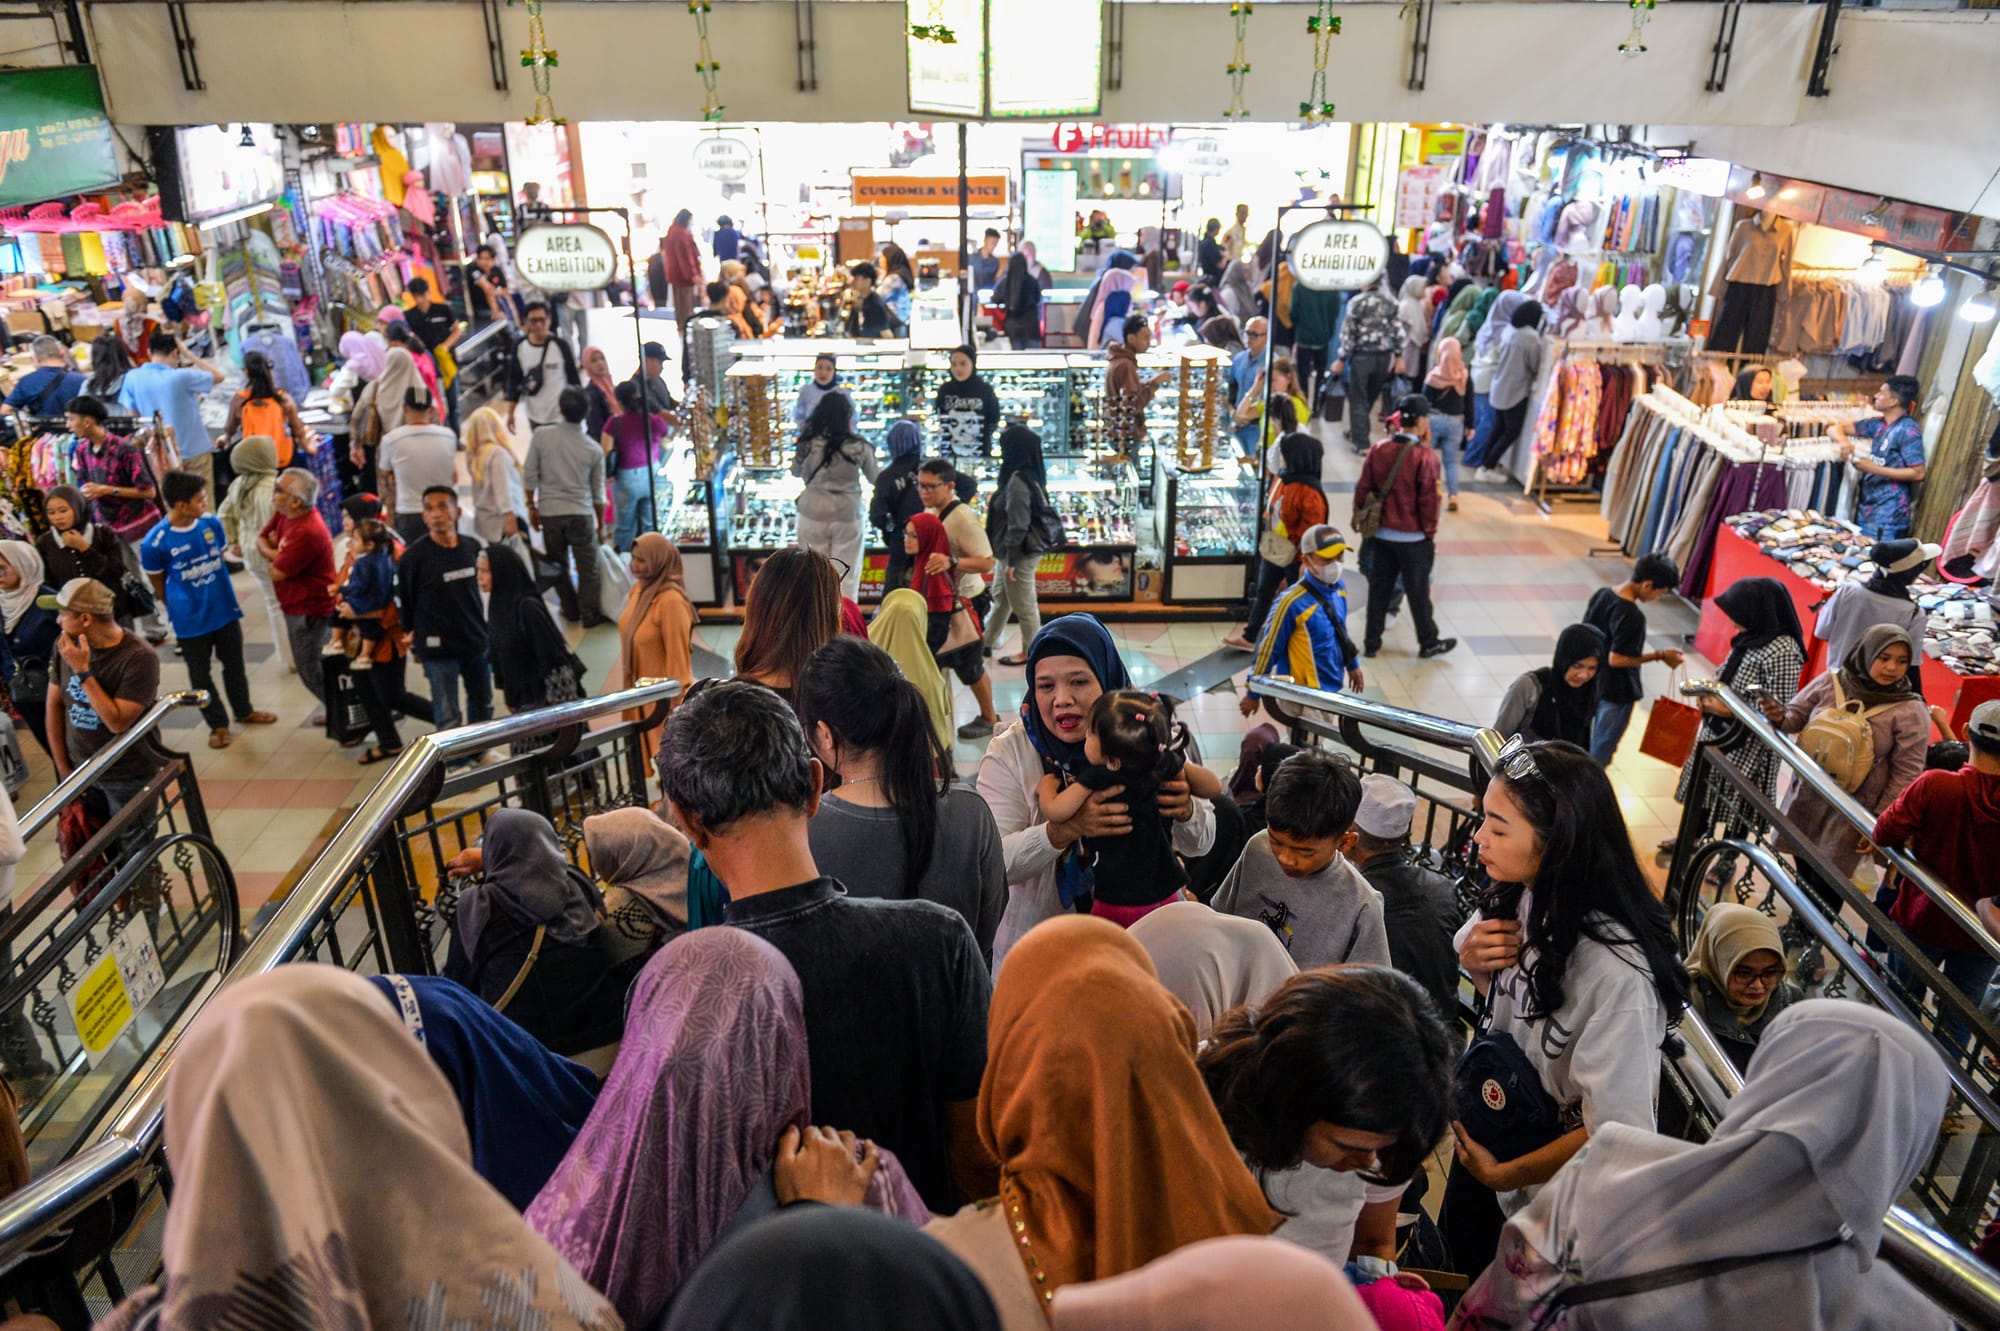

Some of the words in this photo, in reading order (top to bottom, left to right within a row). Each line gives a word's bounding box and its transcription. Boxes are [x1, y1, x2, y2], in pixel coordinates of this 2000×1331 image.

[860, 186, 937, 196] CUSTOMER
[941, 186, 1000, 196] SEVICE
[547, 236, 583, 252] AREA
[1324, 233, 1358, 249] AREA
[527, 257, 606, 273] EXHIBITION
[1301, 253, 1377, 271] EXHIBITION
